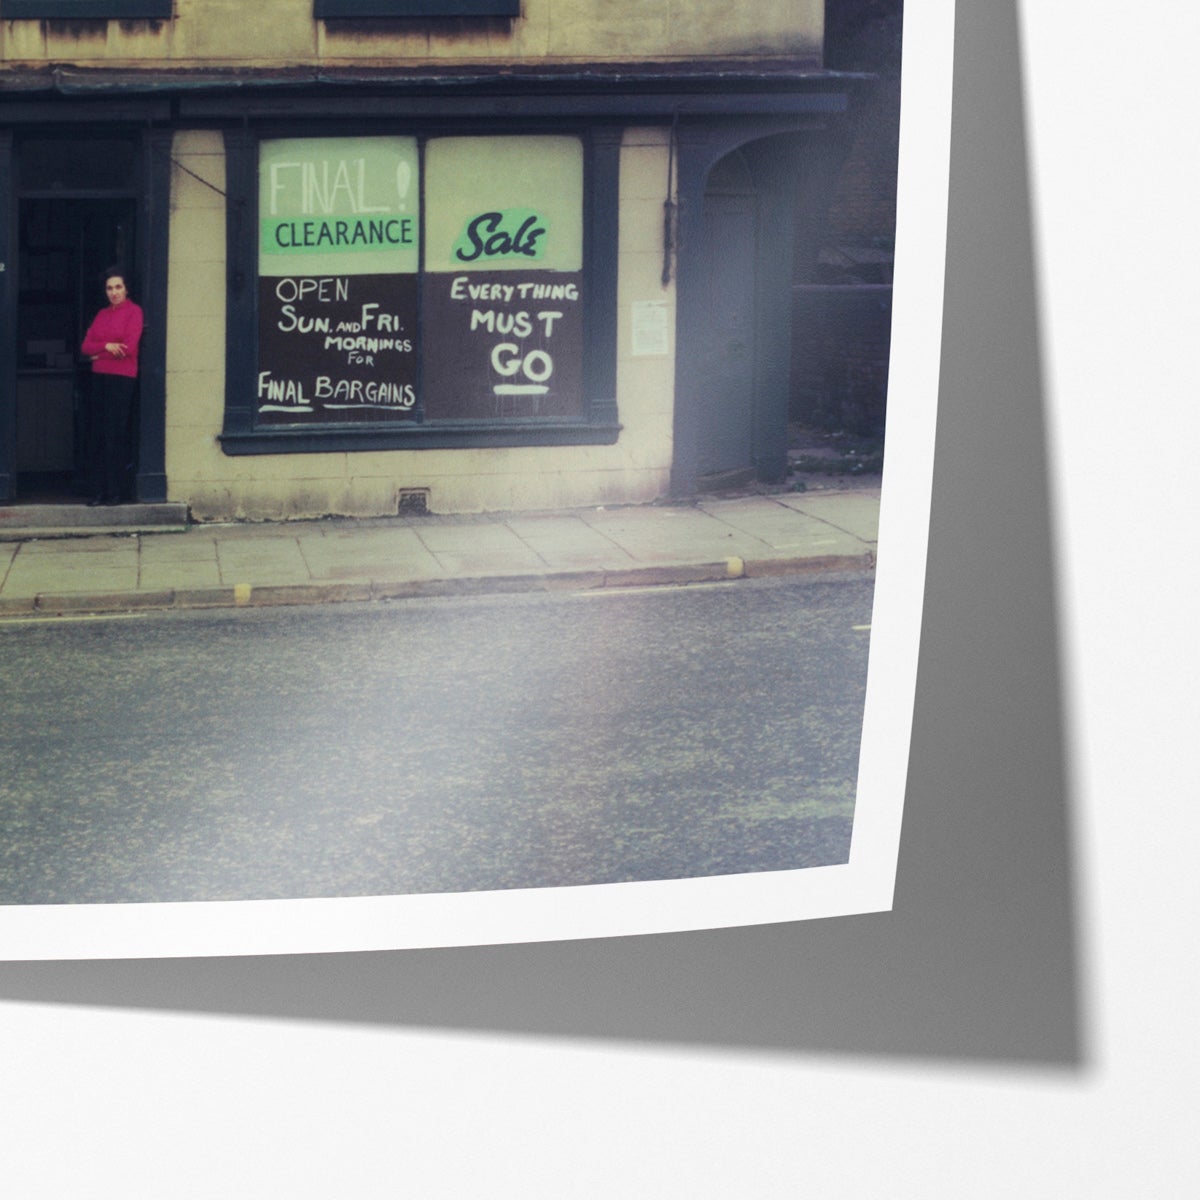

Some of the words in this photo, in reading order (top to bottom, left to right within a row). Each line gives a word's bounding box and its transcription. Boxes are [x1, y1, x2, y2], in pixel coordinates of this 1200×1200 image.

[275, 219, 413, 248] CLEARANCE
[456, 212, 546, 262] Sale
[276, 278, 349, 303] OPEN
[451, 276, 579, 302] EVERYTHING
[336, 321, 361, 333] AND
[470, 309, 564, 338] MUST
[324, 336, 413, 353] MORNINGS
[347, 351, 374, 367] FOR
[491, 342, 553, 382] GO
[258, 371, 311, 404] FINAL
[315, 376, 416, 407] BARGAINS
